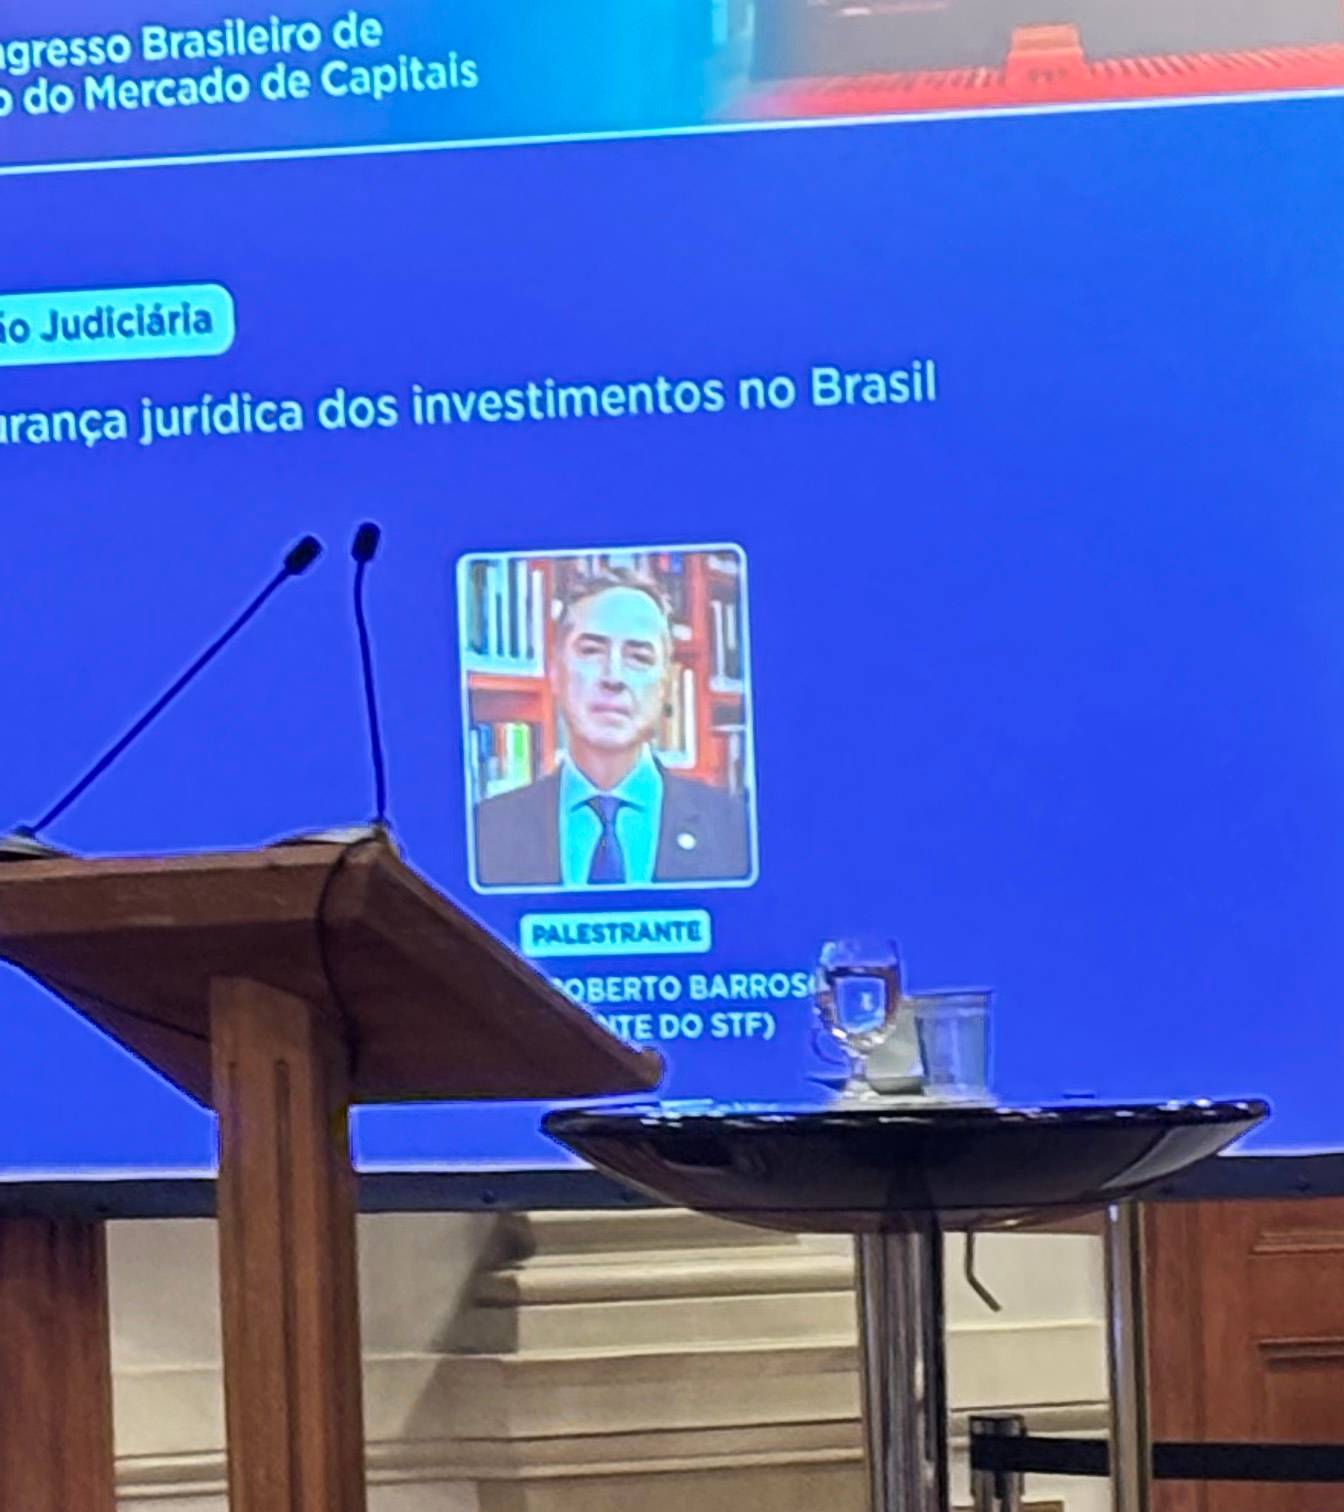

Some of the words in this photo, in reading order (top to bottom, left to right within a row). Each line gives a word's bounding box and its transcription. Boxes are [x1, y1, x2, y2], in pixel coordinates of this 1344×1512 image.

[142, 15, 322, 61] Brasileiro
[332, 10, 383, 48] de
[24, 74, 74, 114] do
[85, 67, 250, 110] Mercado
[260, 64, 310, 100] de
[320, 52, 480, 99] Capitais
[40, 303, 213, 341] Judiciária
[140, 392, 302, 445] jurídica
[317, 387, 398, 429] dos
[412, 377, 724, 424] investimentos
[739, 375, 795, 409] no
[810, 360, 936, 405] Brasil
[533, 920, 702, 945] PALESTRANTE
[689, 972, 814, 1000] BARROS
[659, 1012, 702, 1039] DO
[710, 1011, 775, 1041] STF)
